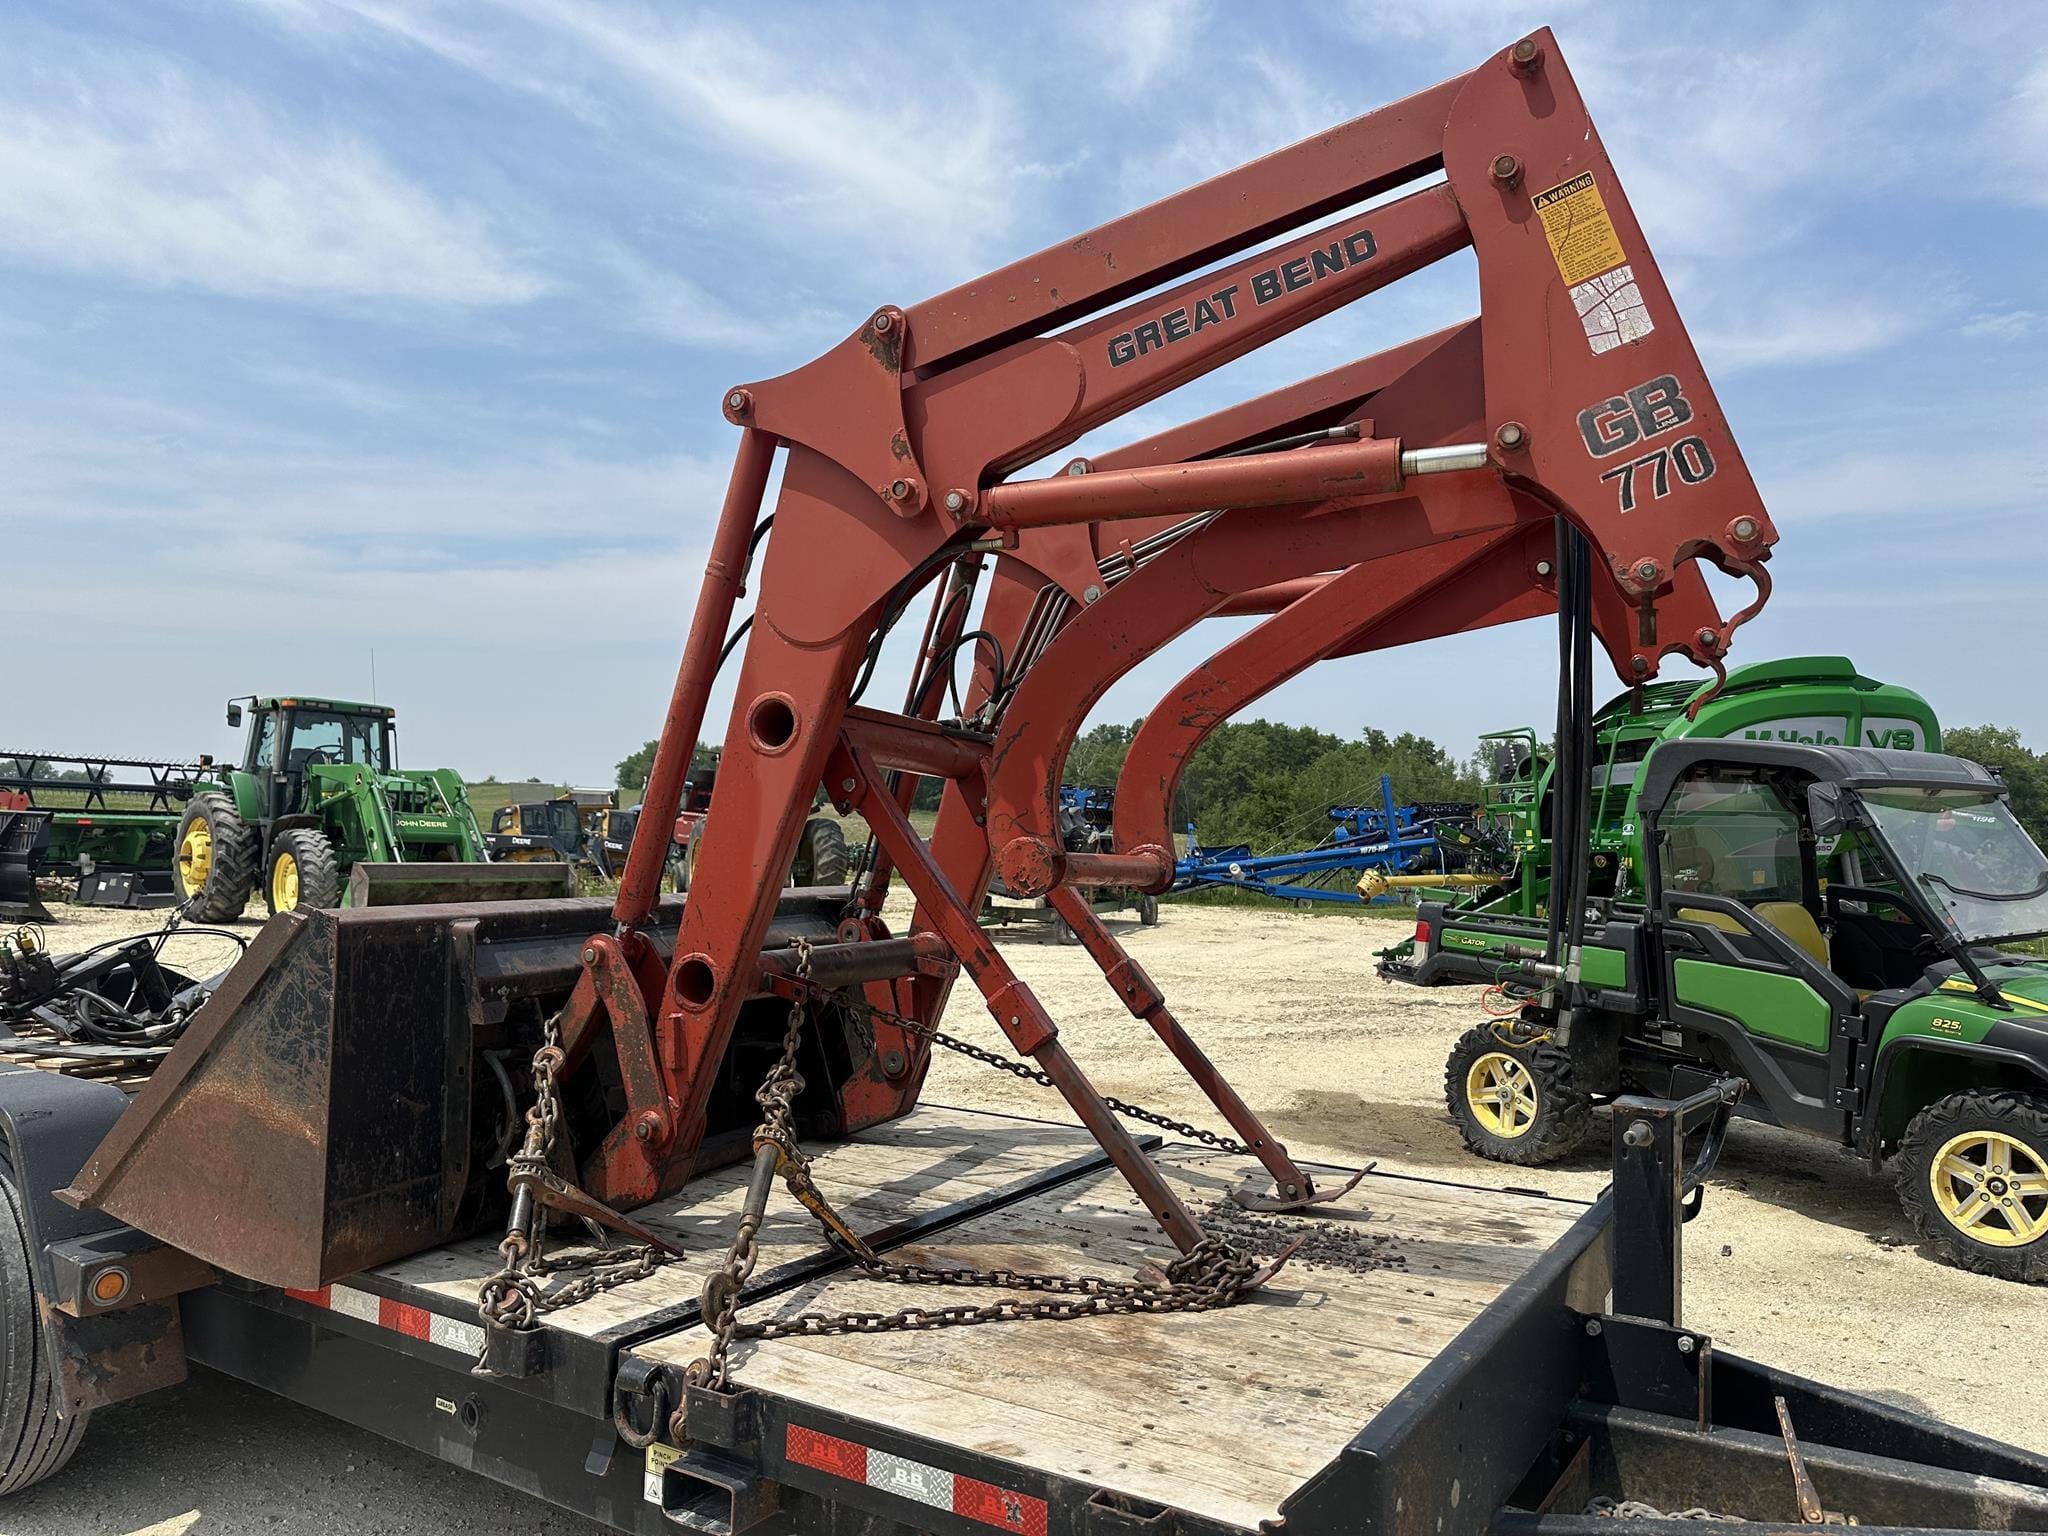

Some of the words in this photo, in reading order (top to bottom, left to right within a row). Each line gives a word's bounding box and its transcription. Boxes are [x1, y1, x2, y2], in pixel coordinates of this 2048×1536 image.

[1548, 176, 1592, 202] WARNING
[1108, 285, 1239, 368] GREAT
[1250, 229, 1378, 305] BEND
[1576, 374, 1694, 459] GB
[1600, 435, 1717, 514] 770
[1866, 728, 1915, 749] V8
[396, 819, 418, 827] JOHN
[419, 820, 448, 828] DEERE
[512, 836, 531, 845] DEERE
[604, 840, 623, 850] DEERE
[1461, 937, 1486, 946] GATOR
[437, 1399, 454, 1411] GREASE
[653, 1449, 671, 1461] PINCH
